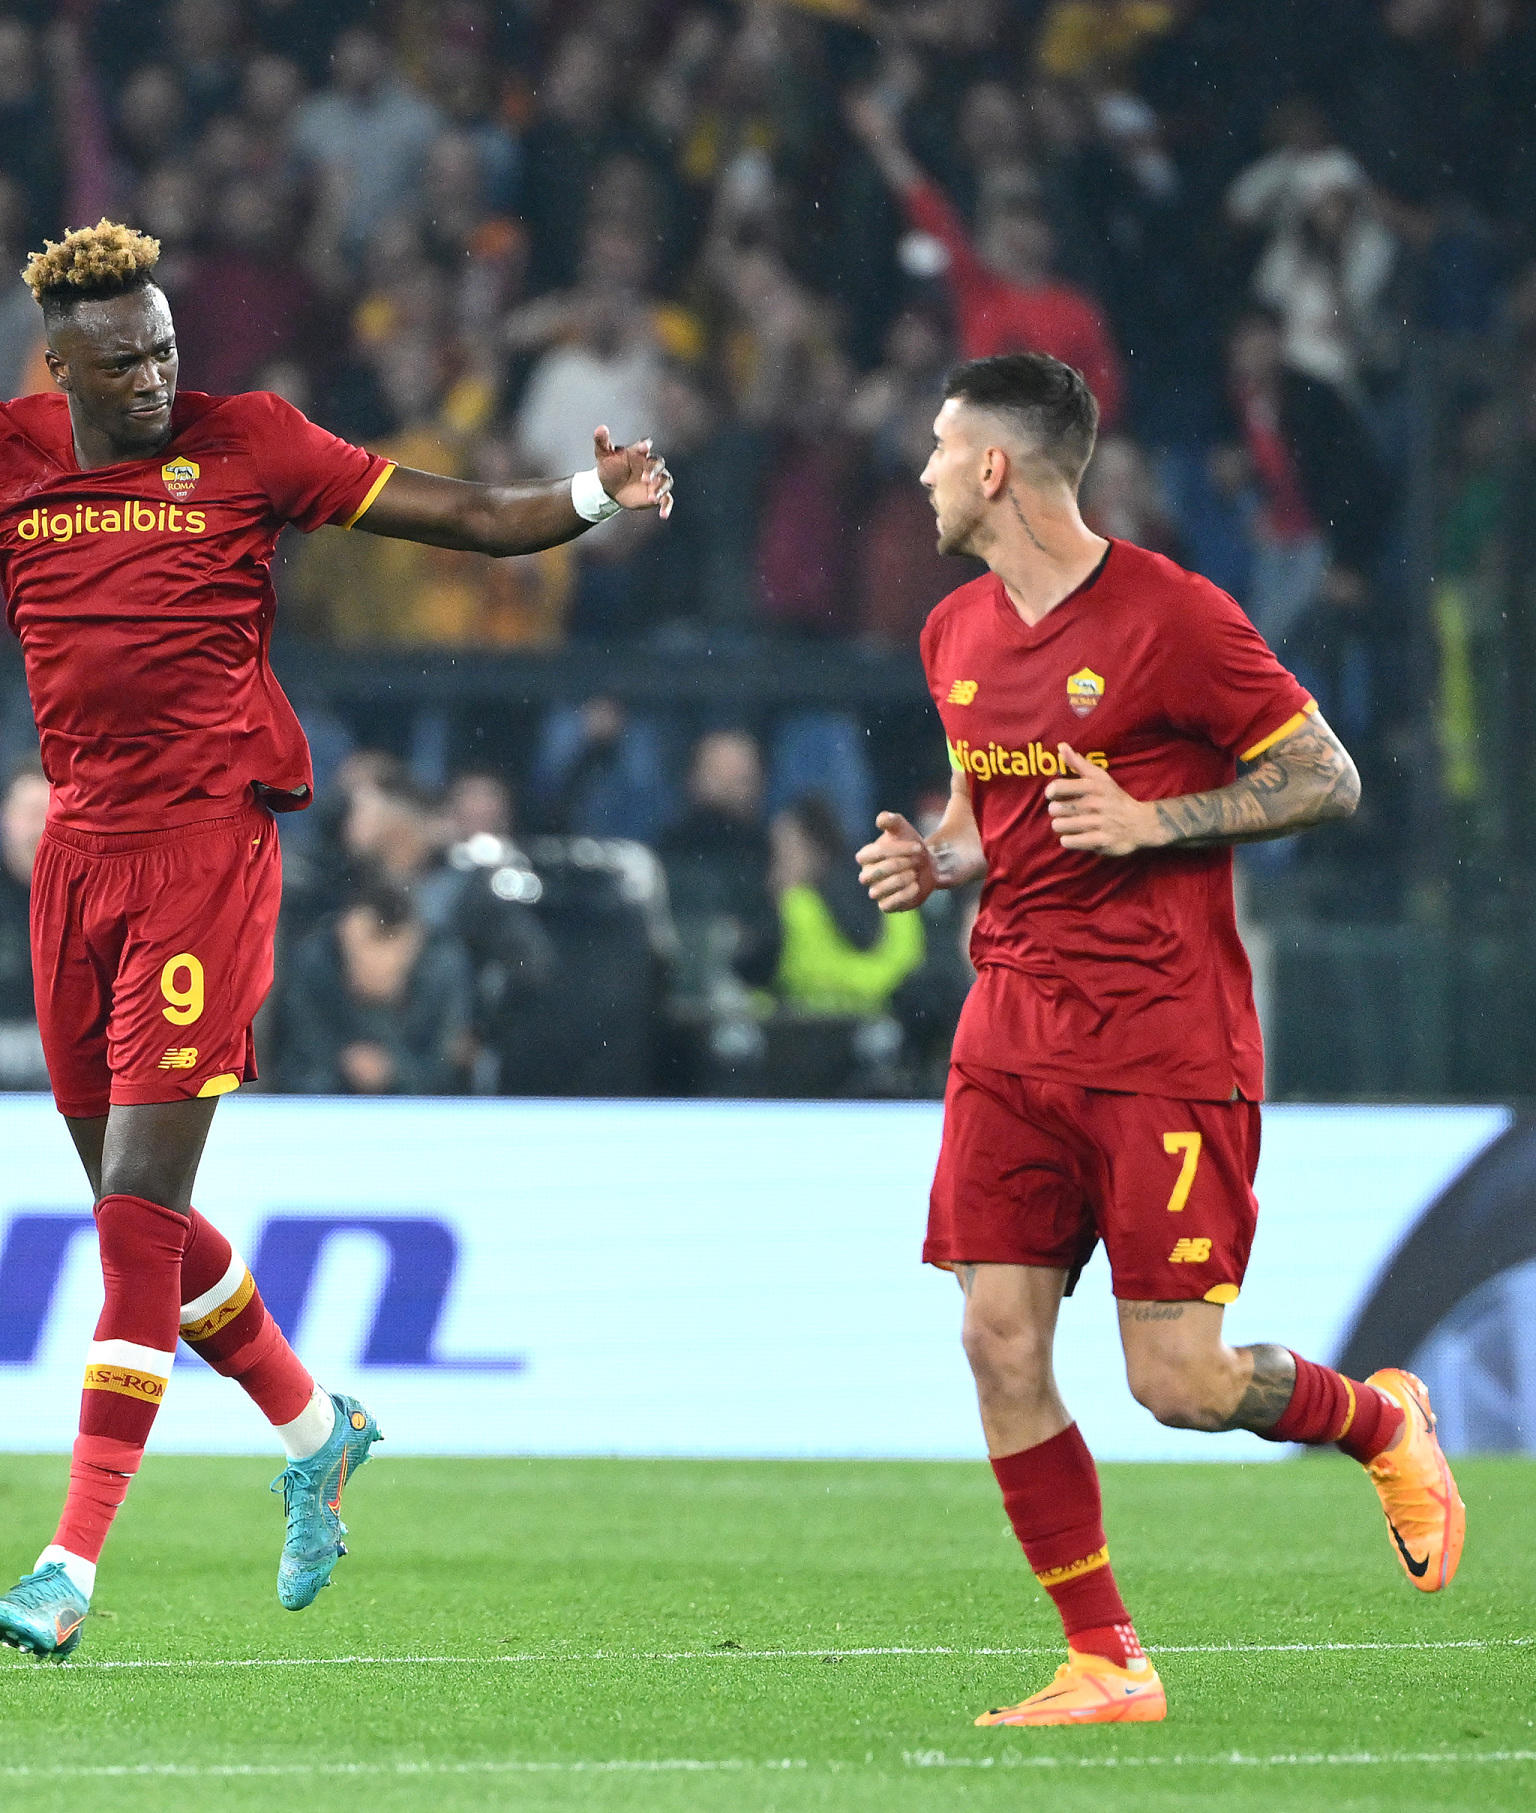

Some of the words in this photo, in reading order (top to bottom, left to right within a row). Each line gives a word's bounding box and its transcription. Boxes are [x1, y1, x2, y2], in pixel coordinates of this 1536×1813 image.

[168, 482, 195, 490] ROMA
[17, 501, 207, 542] digitalbits
[954, 740, 1109, 782] digitalbis
[161, 953, 204, 1025] 9
[1164, 1131, 1202, 1212] 7
